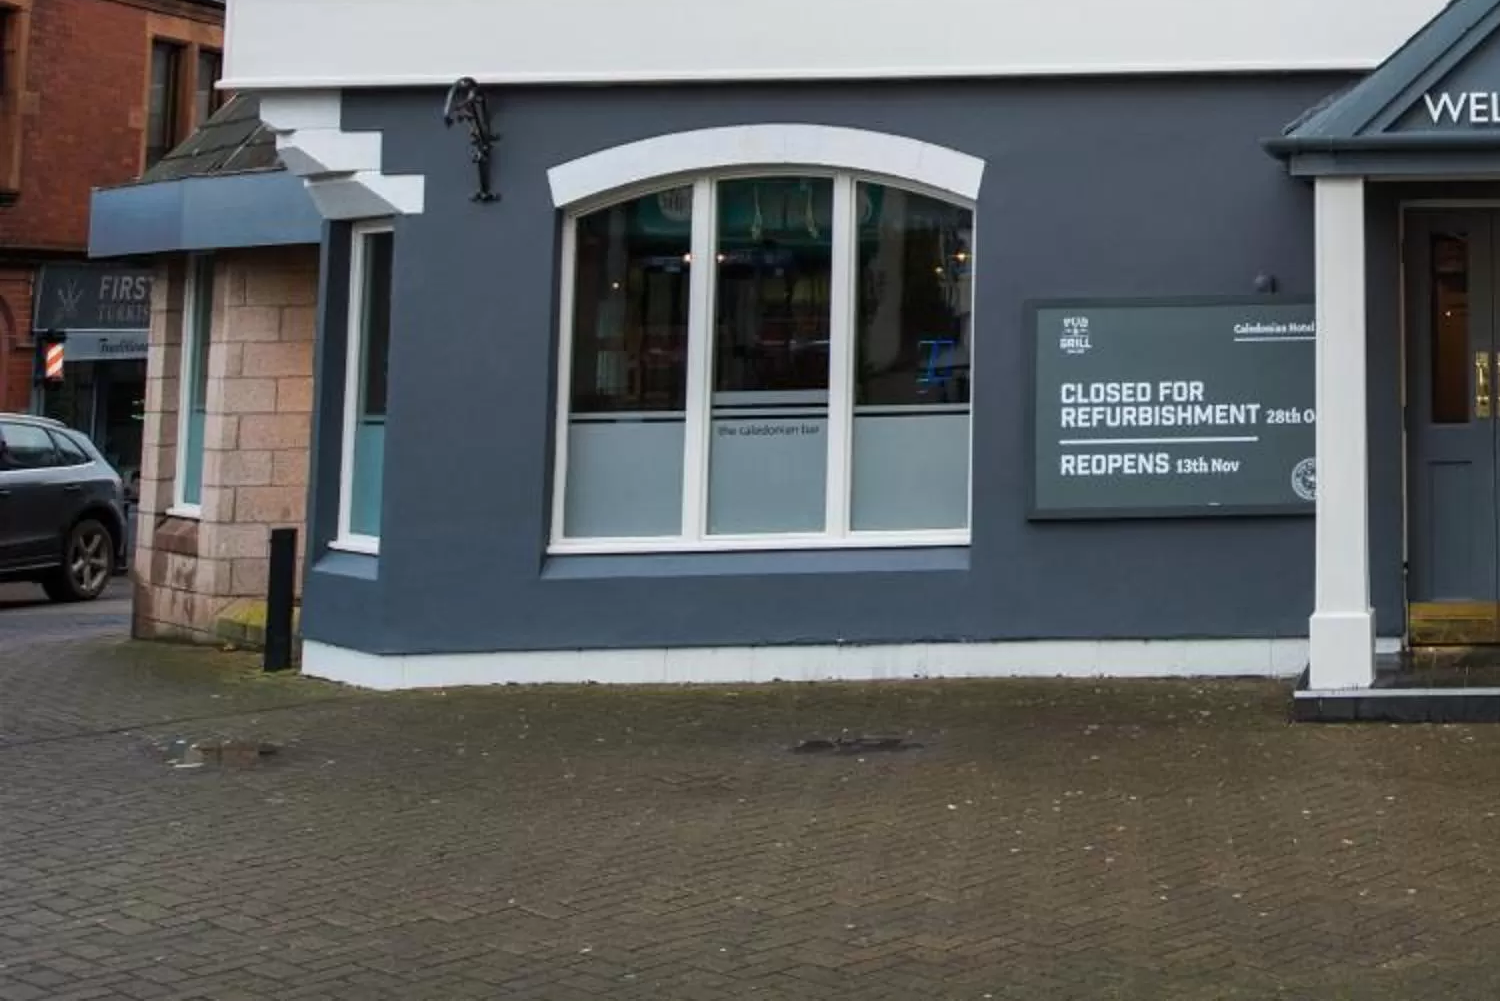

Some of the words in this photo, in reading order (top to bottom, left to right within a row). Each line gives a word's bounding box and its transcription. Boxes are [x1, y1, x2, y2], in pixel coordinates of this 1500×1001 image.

[1060, 382, 1151, 404] CLOSED
[1159, 381, 1205, 402] FOR
[1060, 403, 1261, 428] REFURBISHMENT
[1266, 408, 1301, 424] 28th
[1060, 453, 1170, 476] REOPENS
[1176, 458, 1208, 474] 13th
[1211, 458, 1241, 473] Nov
